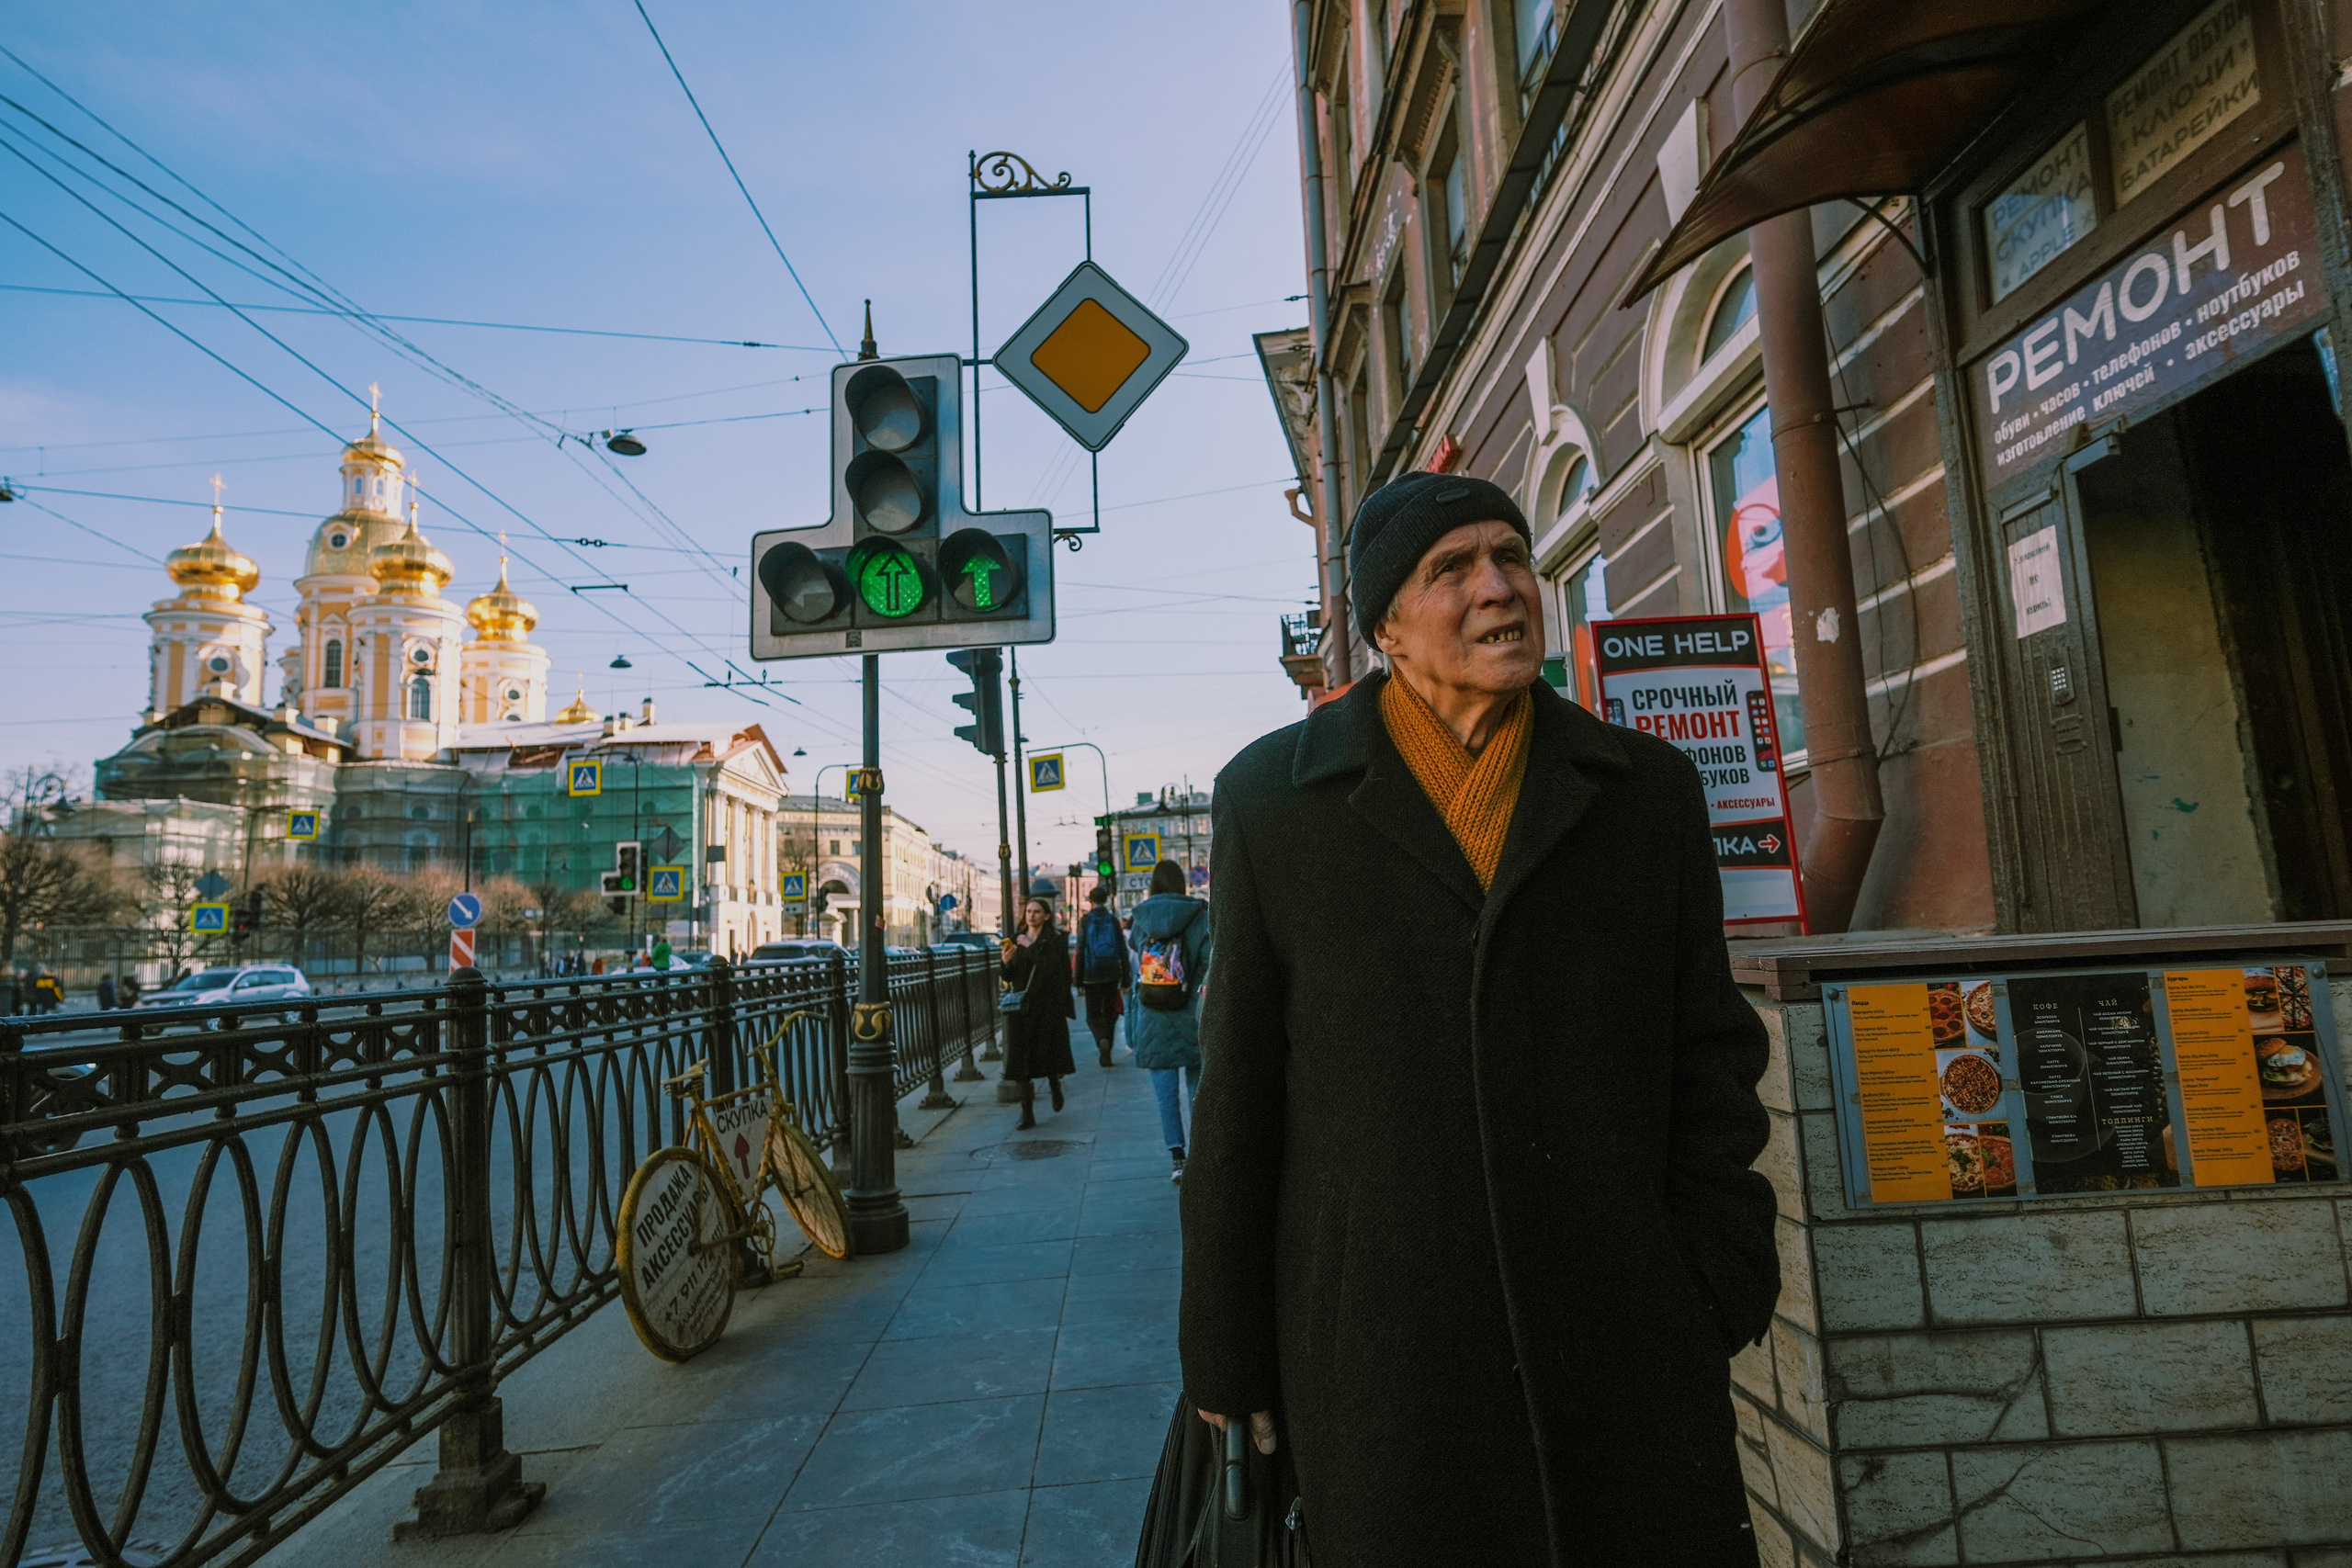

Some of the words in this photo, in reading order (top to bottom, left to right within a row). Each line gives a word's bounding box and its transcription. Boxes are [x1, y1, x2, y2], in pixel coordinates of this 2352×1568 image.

[2131, 45, 2235, 147] КЛЮЧИ
[2120, 69, 2259, 191] БАТАРЕЙКИ
[1995, 132, 2086, 230] РЕМОНТ
[2018, 221, 2075, 280] APPLE
[1987, 162, 2284, 414] РЕМОНТ
[1994, 410, 2030, 446] обуви
[2041, 381, 2080, 416] часов
[2092, 321, 2182, 386] телефонов
[2197, 250, 2301, 323] ноутбуков
[1996, 405, 2086, 467] изготовление
[2092, 362, 2155, 412] ключей
[2185, 279, 2305, 361] аксессуары
[1603, 635, 1666, 659] ONE
[1673, 630, 1750, 655] HELP
[1631, 679, 1738, 711] СРОЧНЫЙ
[1634, 710, 1741, 742] РЕМОНТ
[1685, 746, 1747, 769] ФОНОВ
[1702, 769, 1751, 791] БУКОВ
[1716, 797, 1776, 812] АКСЕССУАРЫ
[1129, 877, 1152, 887] СТО
[2098, 998, 2118, 1007] ЧАЙ
[717, 1100, 769, 1134] СКУПКА
[2101, 1116, 2154, 1125] ТОППИНГИ
[636, 1163, 693, 1247] ПРОДАЖА
[640, 1180, 711, 1290] АКСЕССУАРЫ
[681, 1270, 698, 1300] 911
